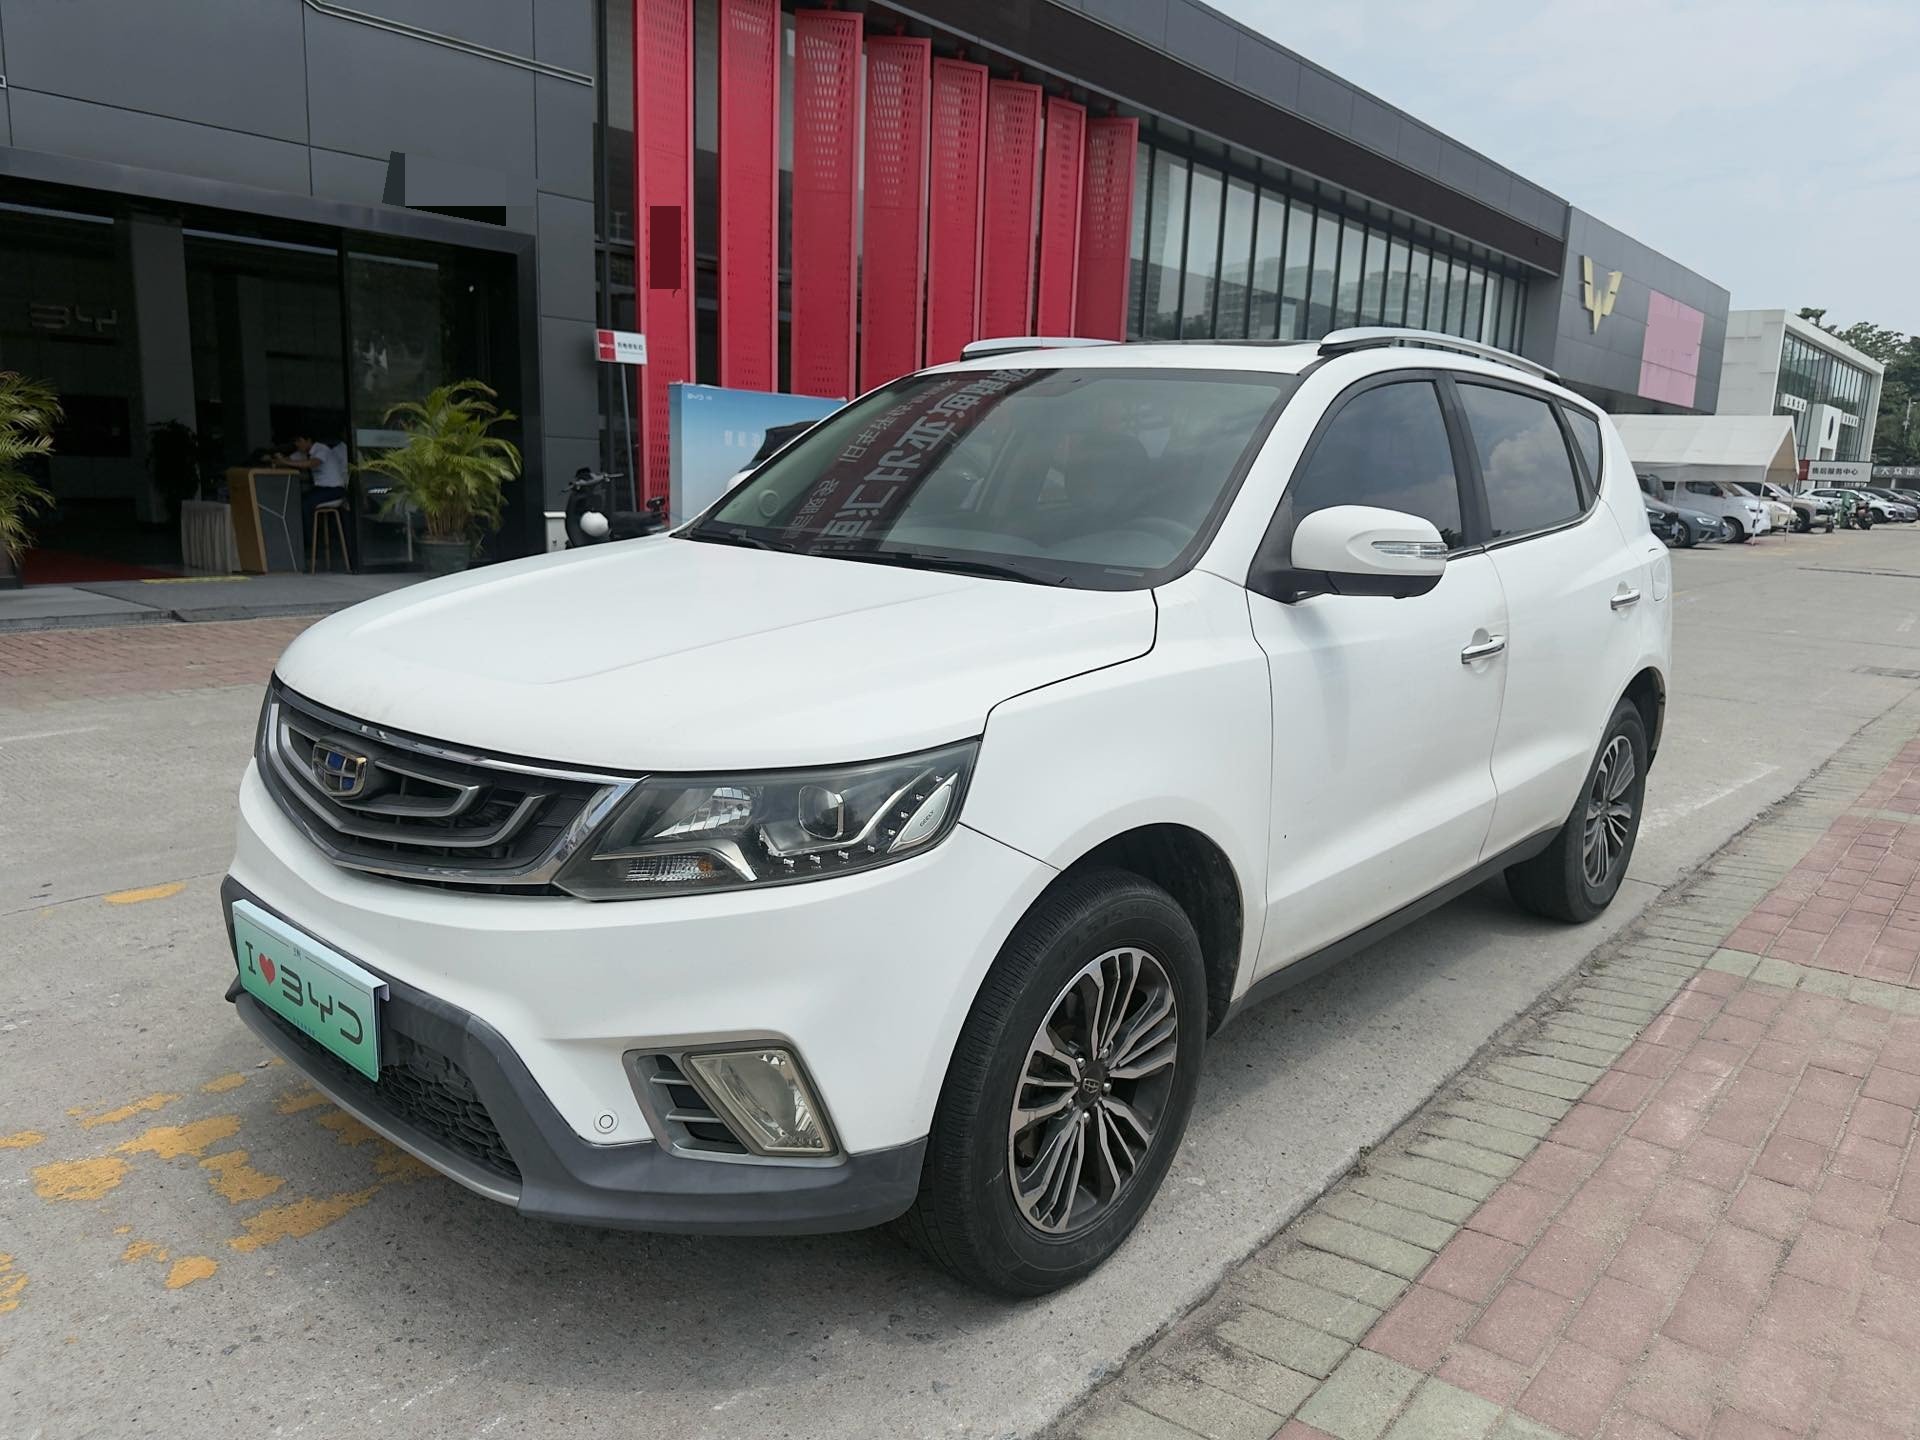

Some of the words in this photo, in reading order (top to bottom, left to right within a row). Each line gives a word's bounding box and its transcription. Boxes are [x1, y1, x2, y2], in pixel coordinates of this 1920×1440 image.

[1812, 467, 1858, 476] 售后服务中心
[244, 940, 257, 975] I
[280, 964, 364, 1045] BYD
